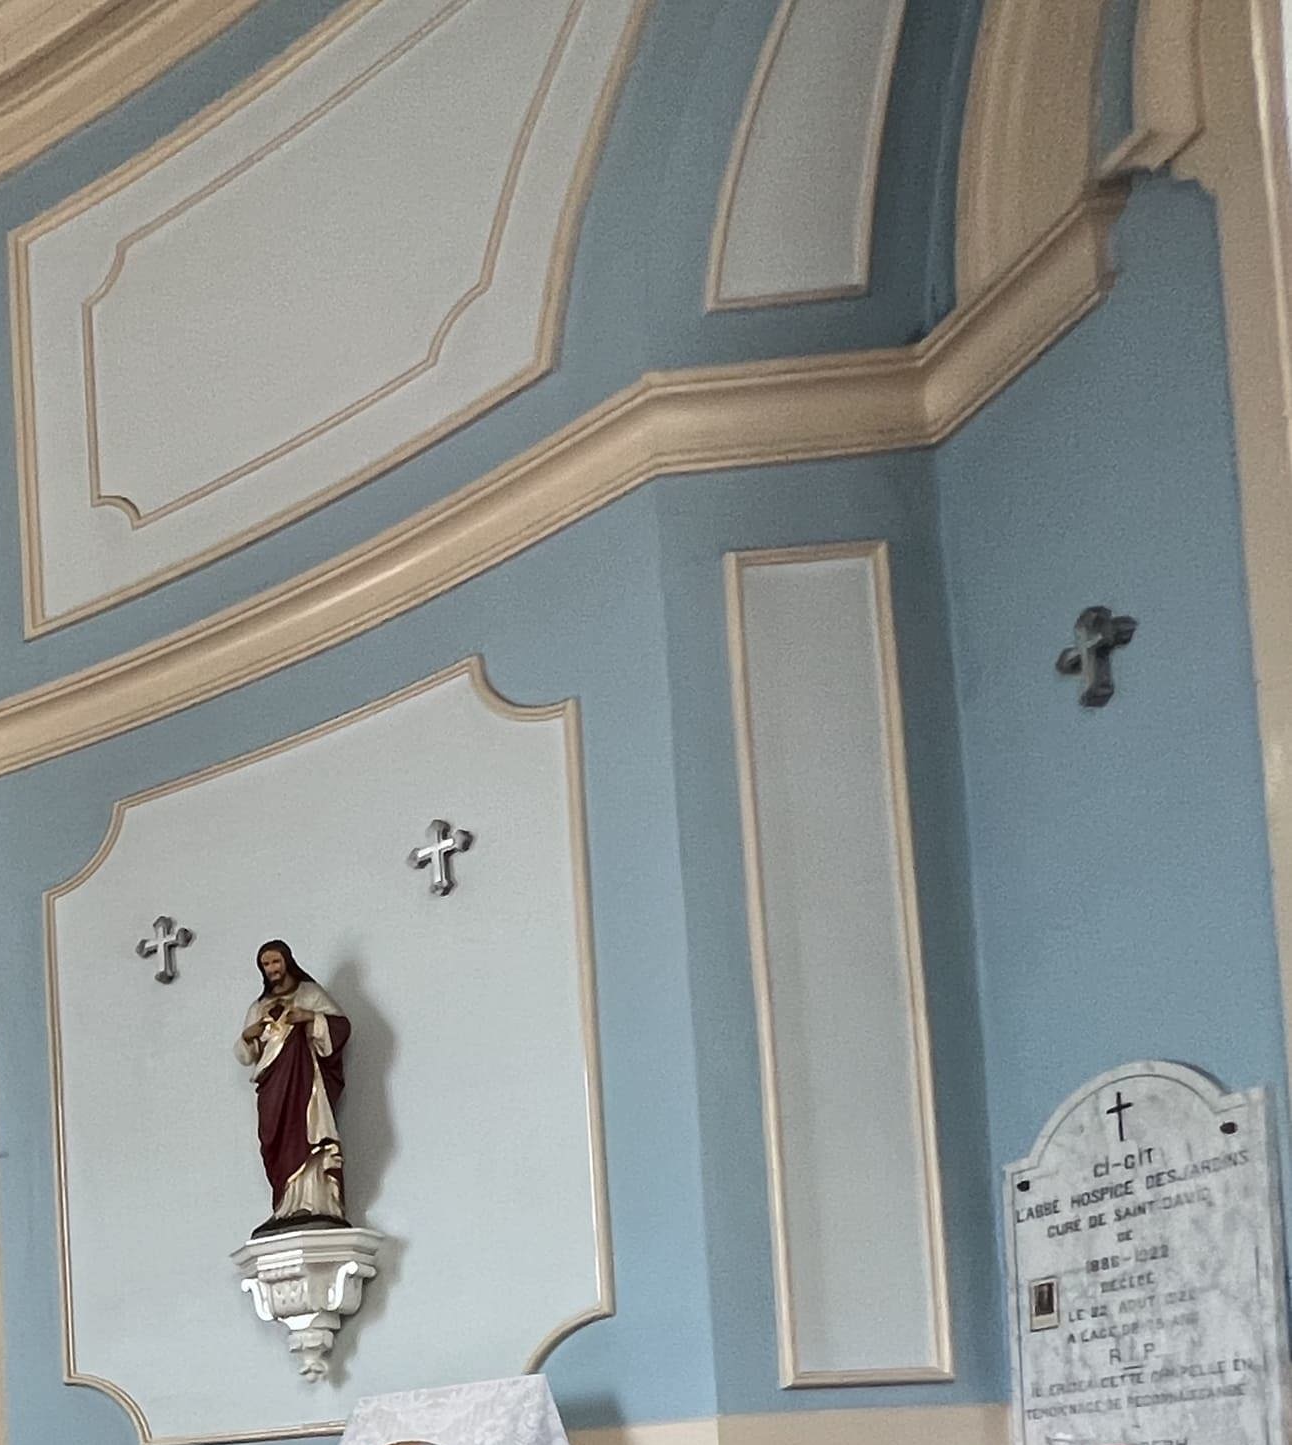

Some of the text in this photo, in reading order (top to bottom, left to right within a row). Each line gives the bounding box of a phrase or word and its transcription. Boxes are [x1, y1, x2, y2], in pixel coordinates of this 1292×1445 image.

[1070, 1179, 1134, 1208] HOSPICE
[1088, 1213, 1106, 1229] DE
[1117, 1229, 1133, 1242] DE
[1068, 1308, 1085, 1322] LE
[1101, 1372, 1145, 1388] CETTE
